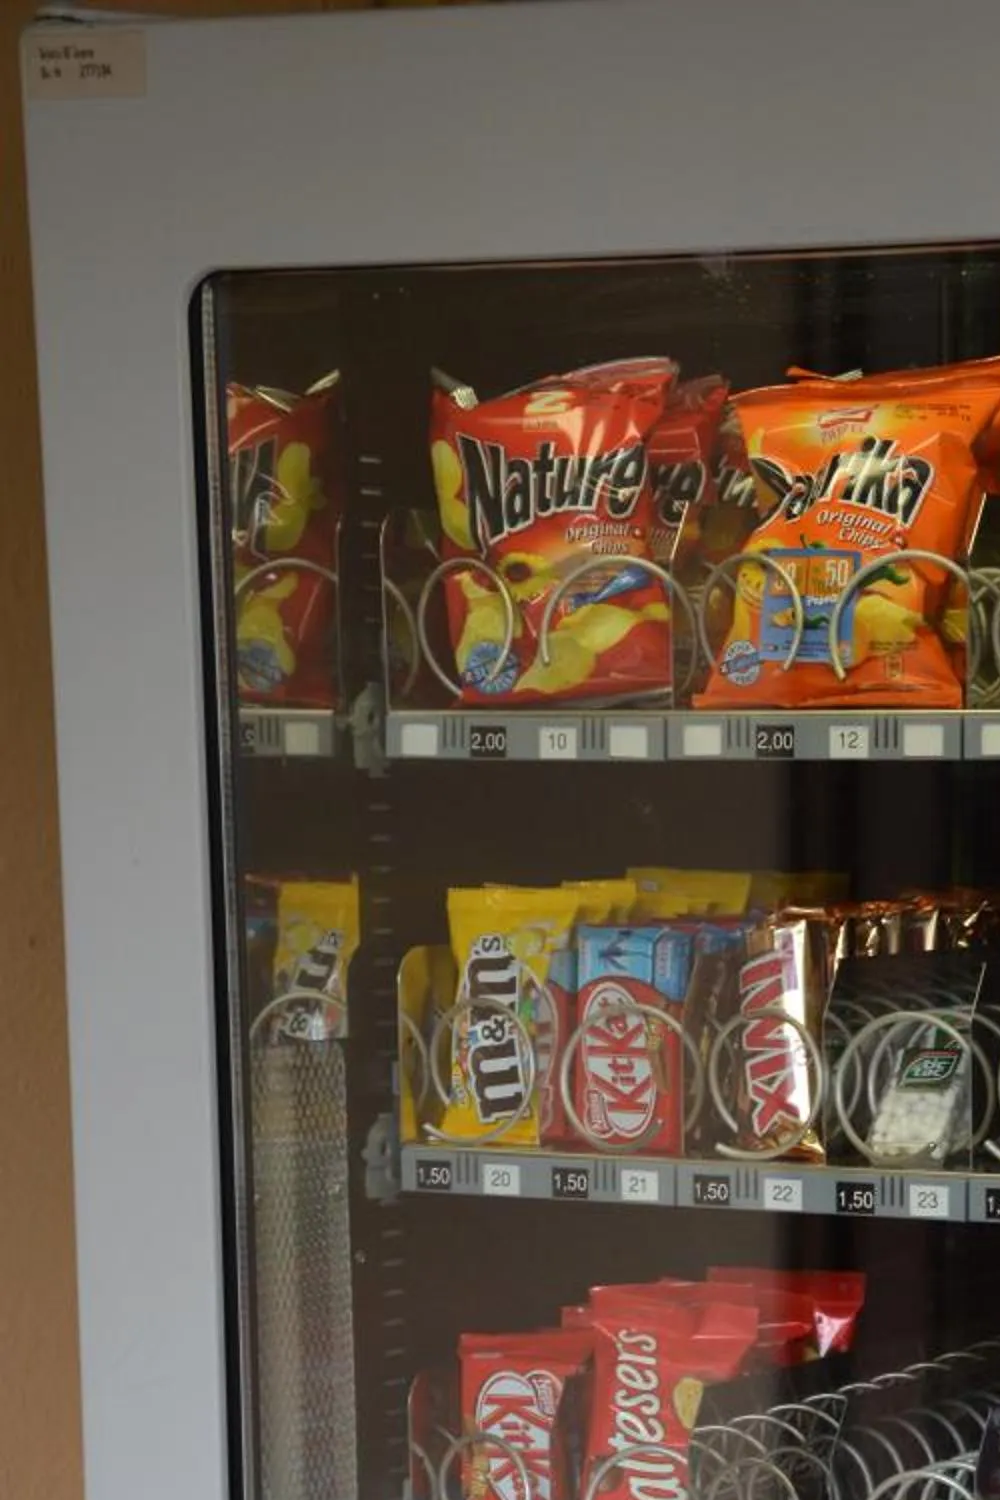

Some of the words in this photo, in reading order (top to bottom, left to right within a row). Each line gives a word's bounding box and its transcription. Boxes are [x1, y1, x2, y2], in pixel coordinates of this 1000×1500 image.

[457, 432, 648, 560] Nature
[815, 510, 892, 536] Original
[548, 732, 567, 751] 10
[838, 732, 859, 750] 12
[491, 1167, 510, 1187] 20
[629, 1177, 647, 1193] 21
[773, 1185, 793, 1202] 22
[917, 1192, 938, 1209] 23
